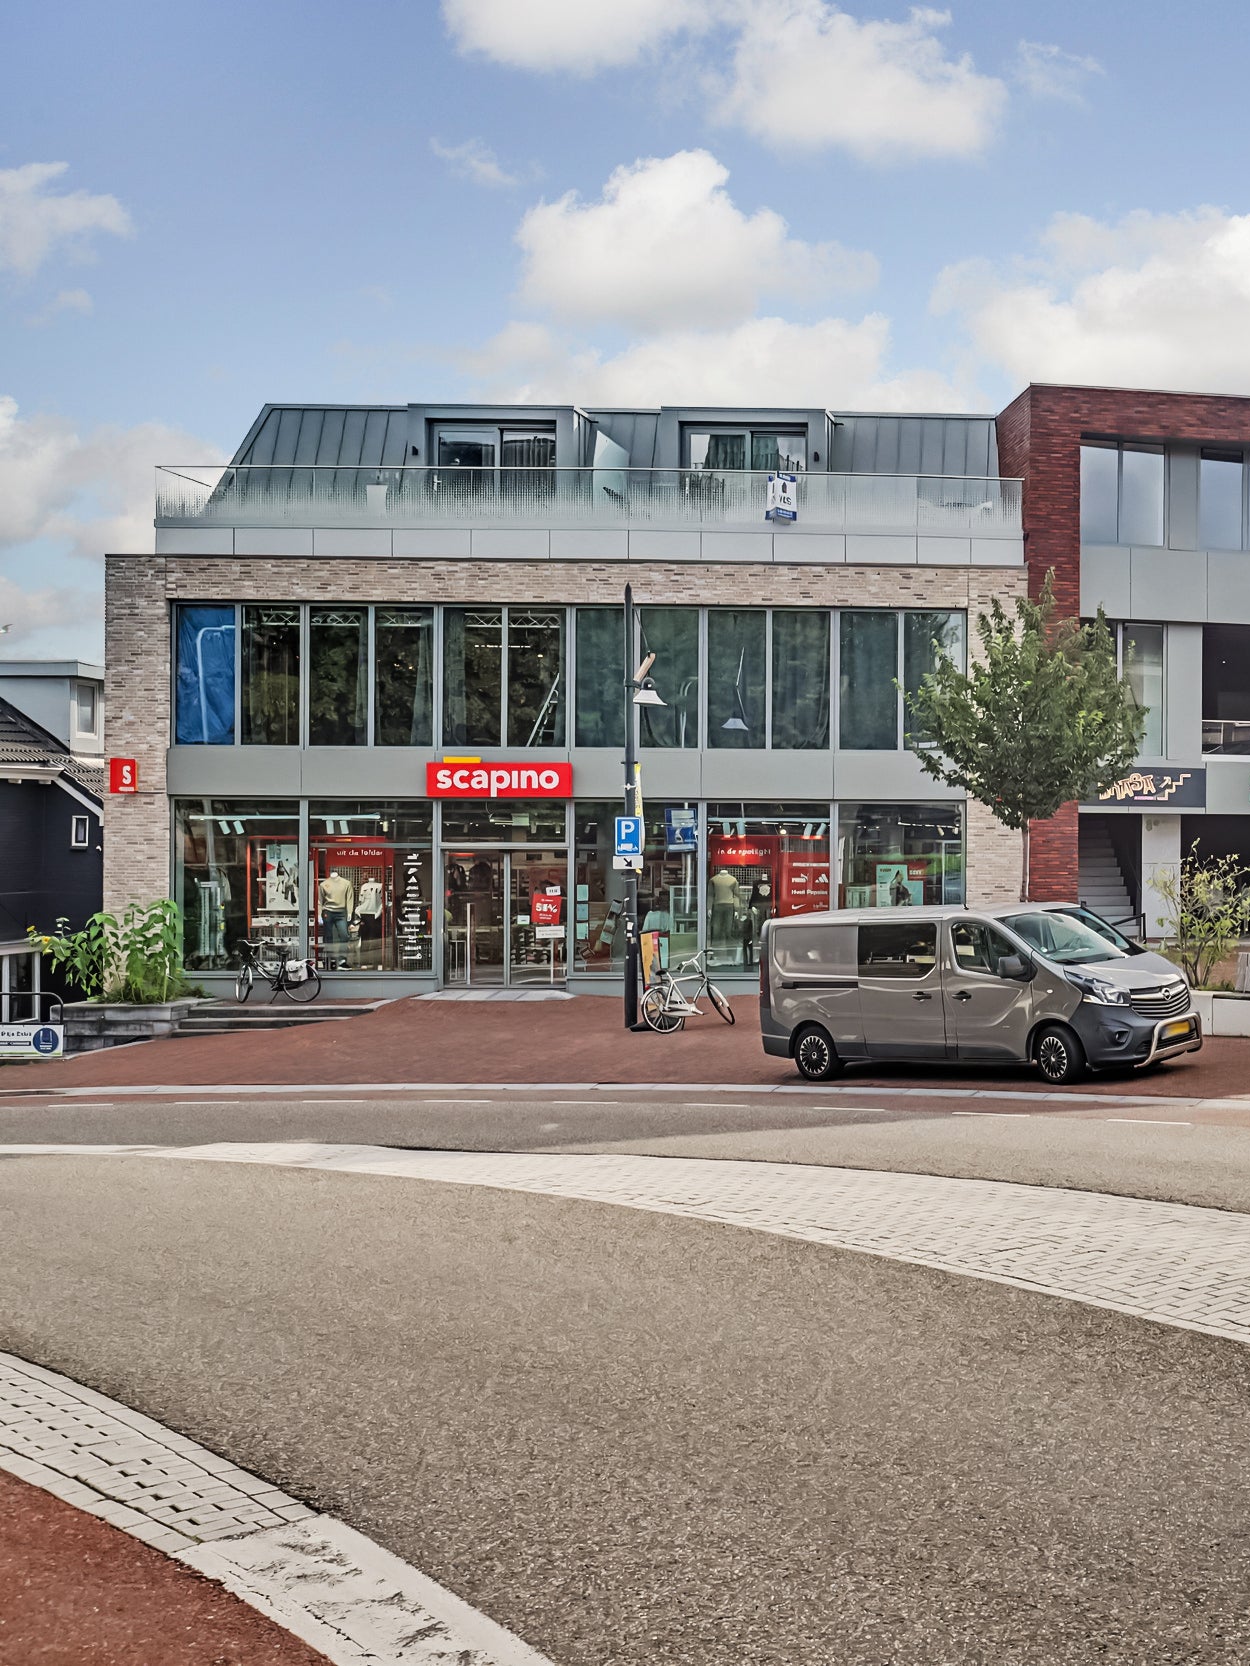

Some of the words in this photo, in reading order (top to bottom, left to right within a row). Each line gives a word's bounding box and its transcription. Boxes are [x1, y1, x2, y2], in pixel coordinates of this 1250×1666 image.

[122, 765, 132, 785] S
[436, 769, 560, 798] scapino
[621, 821, 635, 840] P
